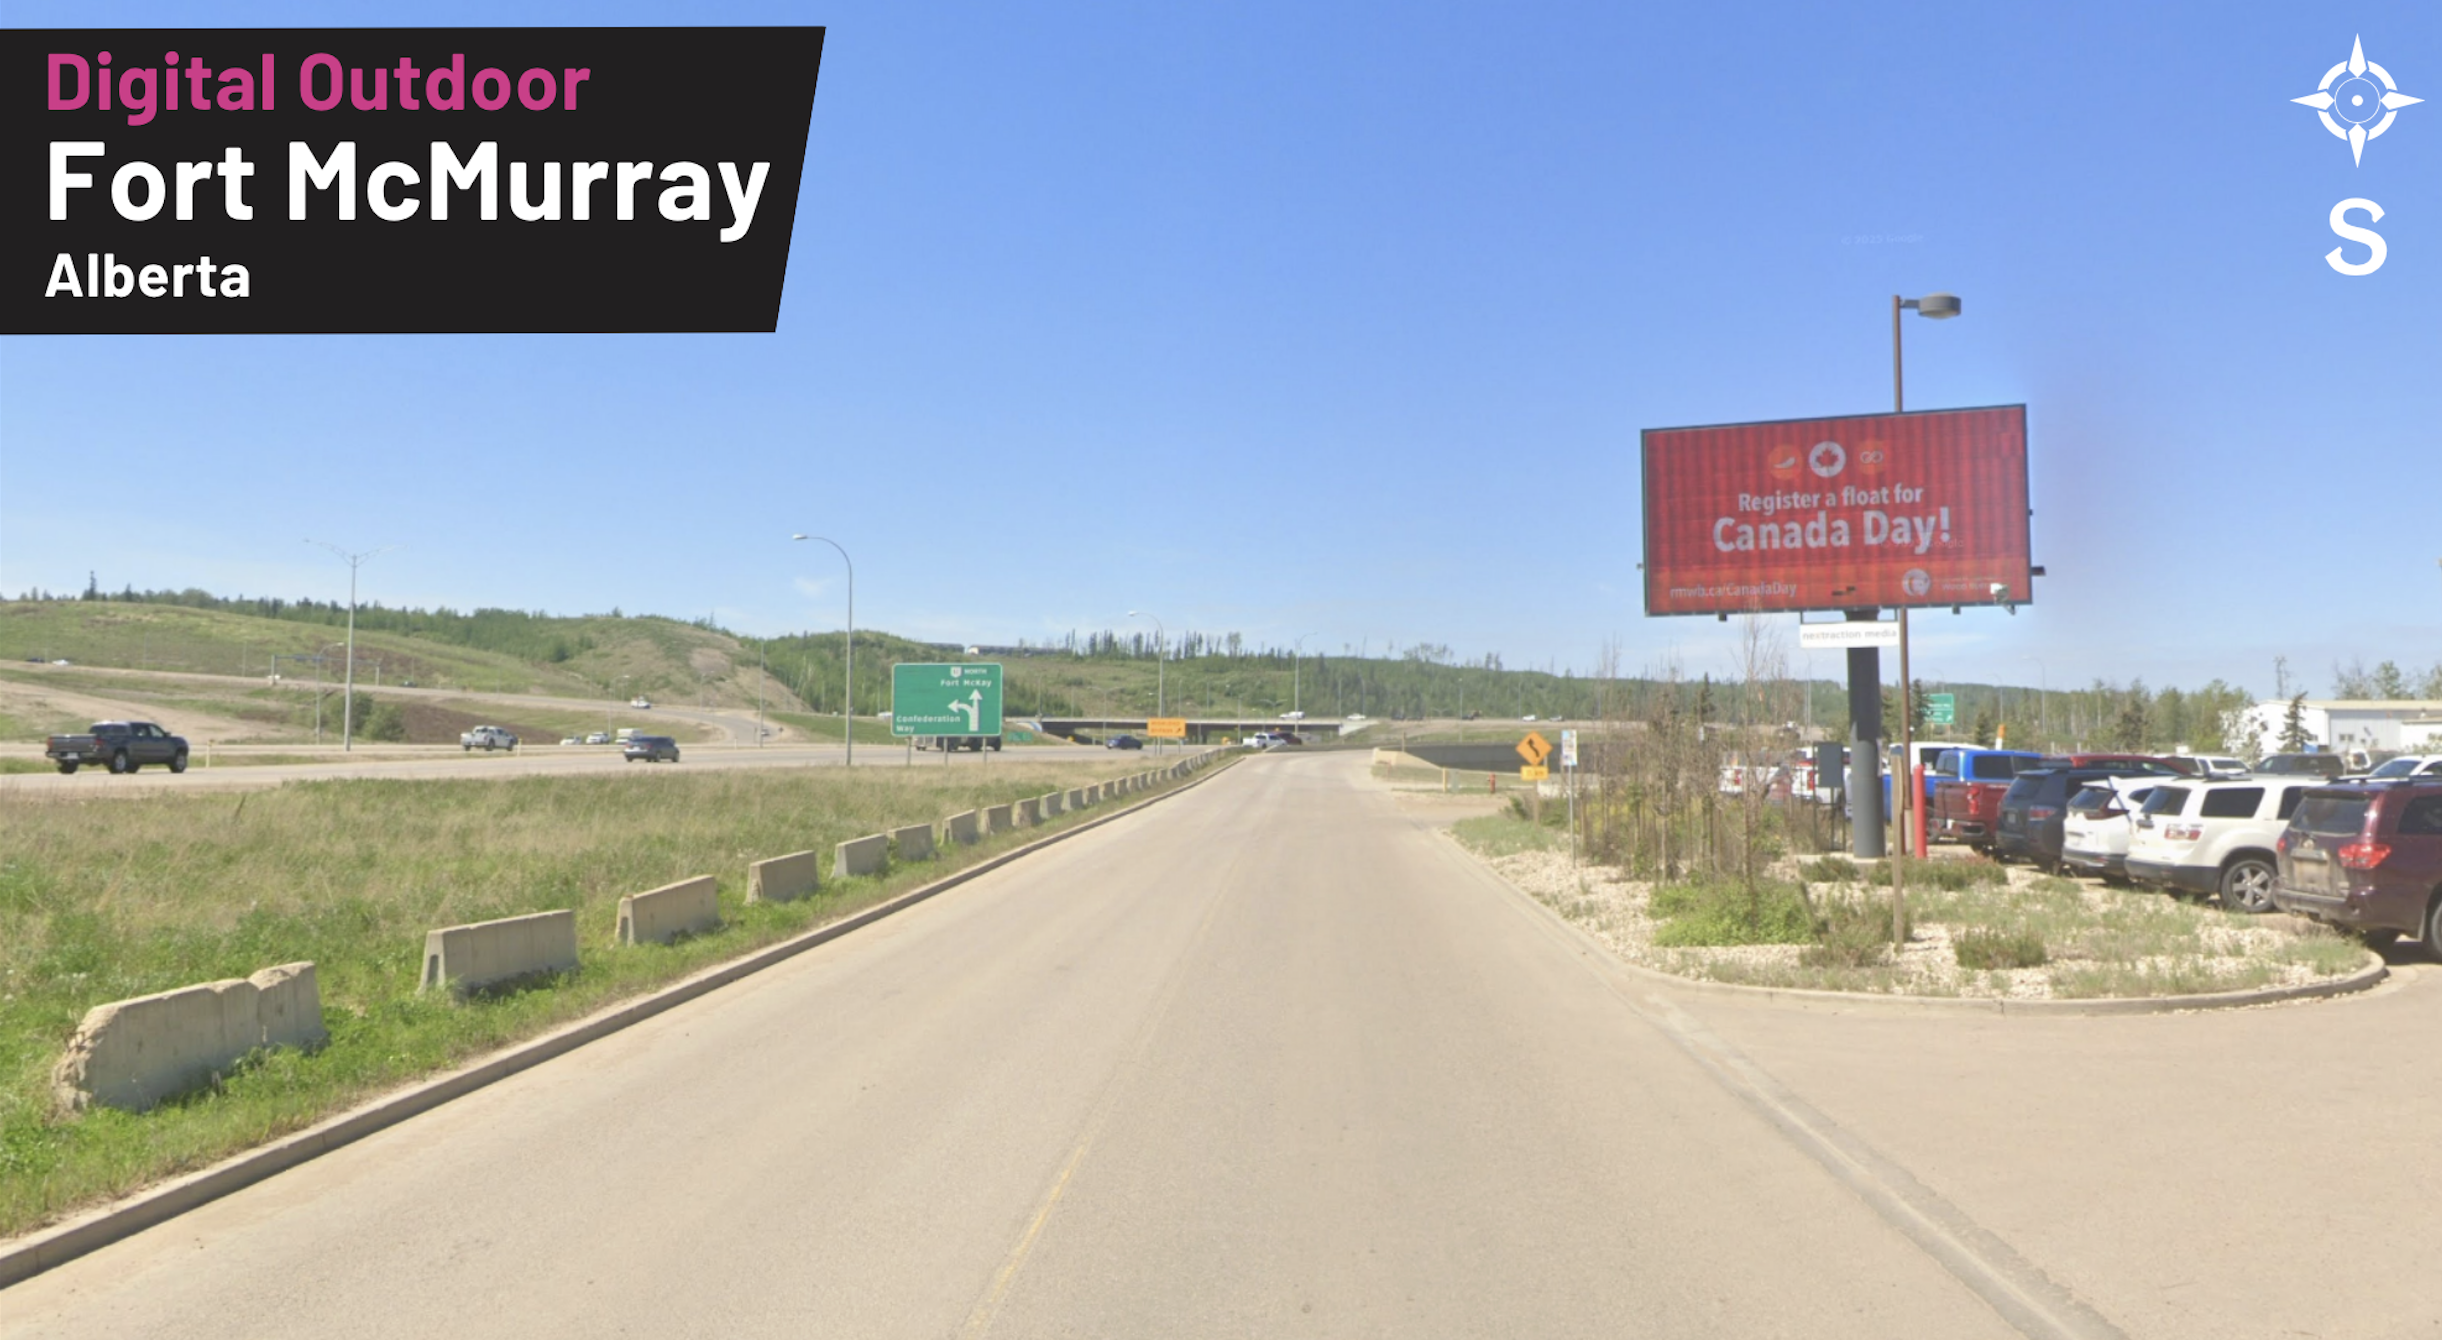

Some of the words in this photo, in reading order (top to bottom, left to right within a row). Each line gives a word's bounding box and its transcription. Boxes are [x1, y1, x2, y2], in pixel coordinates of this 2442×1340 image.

[1738, 490, 1820, 516] Register
[1825, 492, 1836, 507] a
[1842, 485, 1889, 506] float
[1893, 483, 1924, 504] for
[1713, 510, 1850, 552] Canada
[1863, 506, 1950, 555] Day!
[1669, 581, 1798, 599] rmwb.ca/CanadaDay
[1802, 630, 1862, 641] nextraction
[1864, 628, 1897, 639] media
[940, 679, 960, 687] Fort
[963, 679, 992, 688] McKay
[896, 714, 961, 723] Confederation
[896, 724, 915, 734] Way
